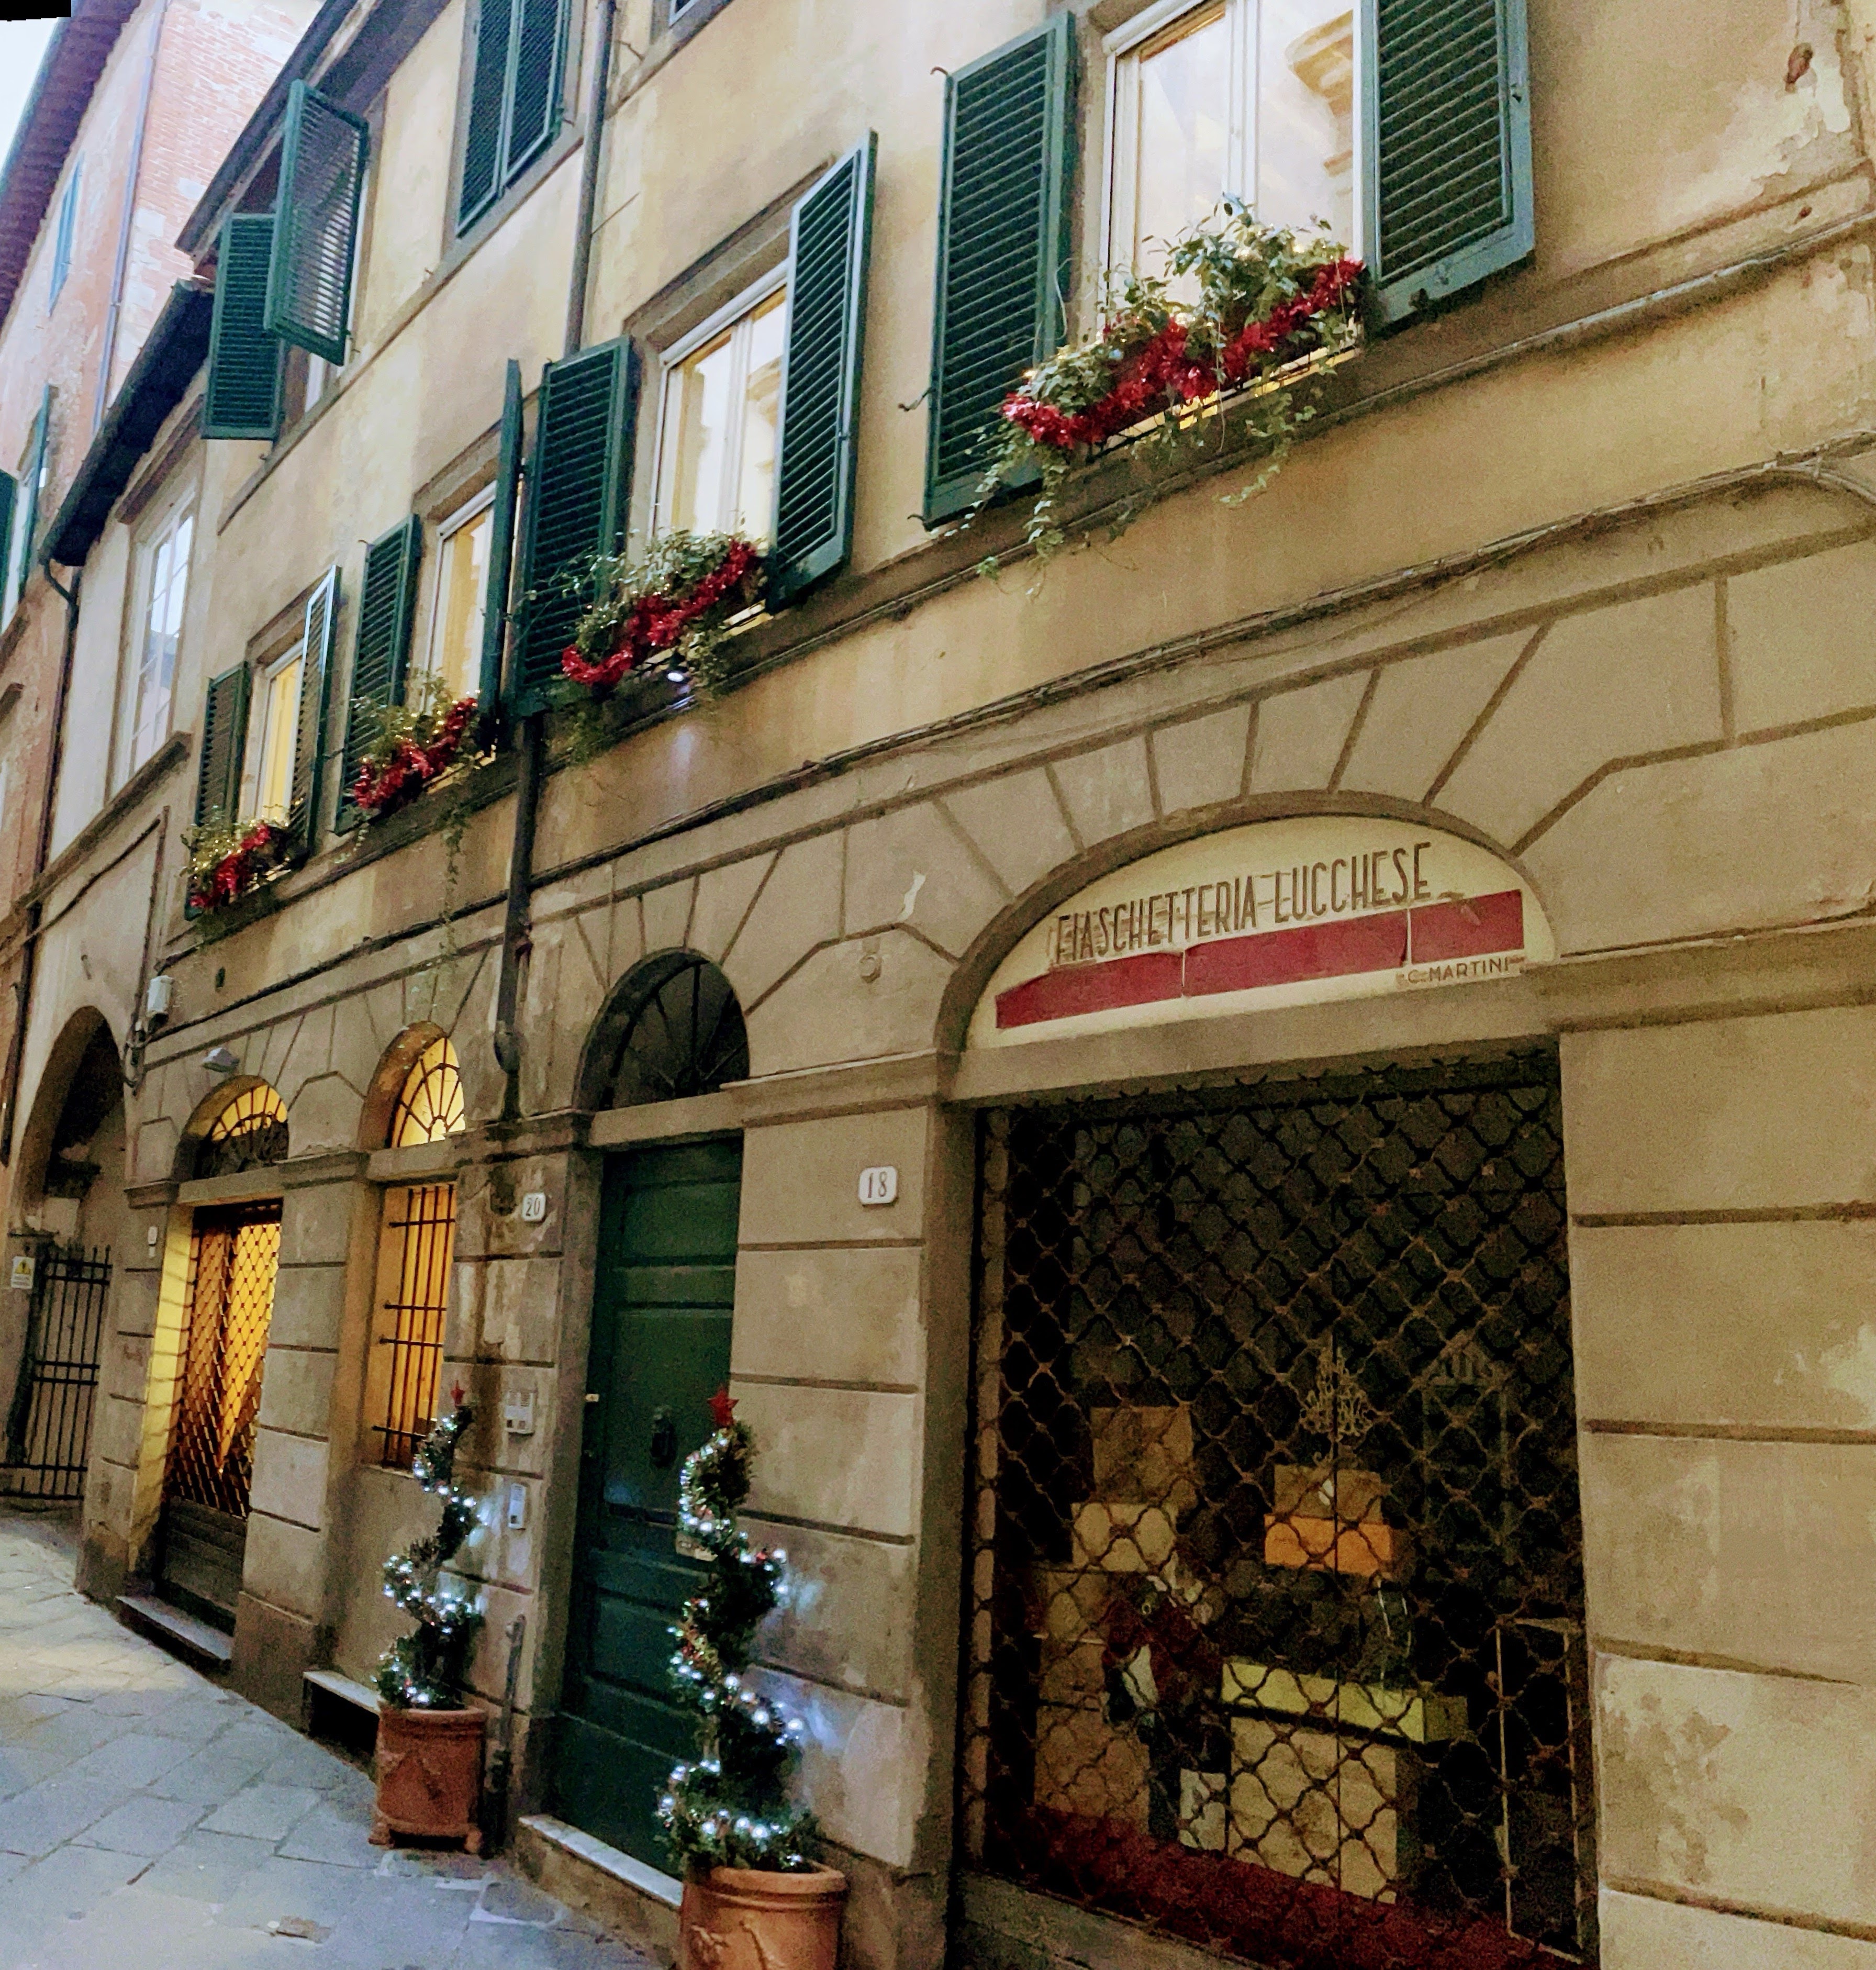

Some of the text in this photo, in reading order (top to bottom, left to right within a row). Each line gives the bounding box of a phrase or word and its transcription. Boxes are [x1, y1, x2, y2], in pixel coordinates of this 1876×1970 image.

[1275, 841, 1432, 923] LUCCHESE
[1429, 956, 1508, 982] MARTINI
[867, 1171, 888, 1198] 18
[525, 1197, 541, 1217] 20
